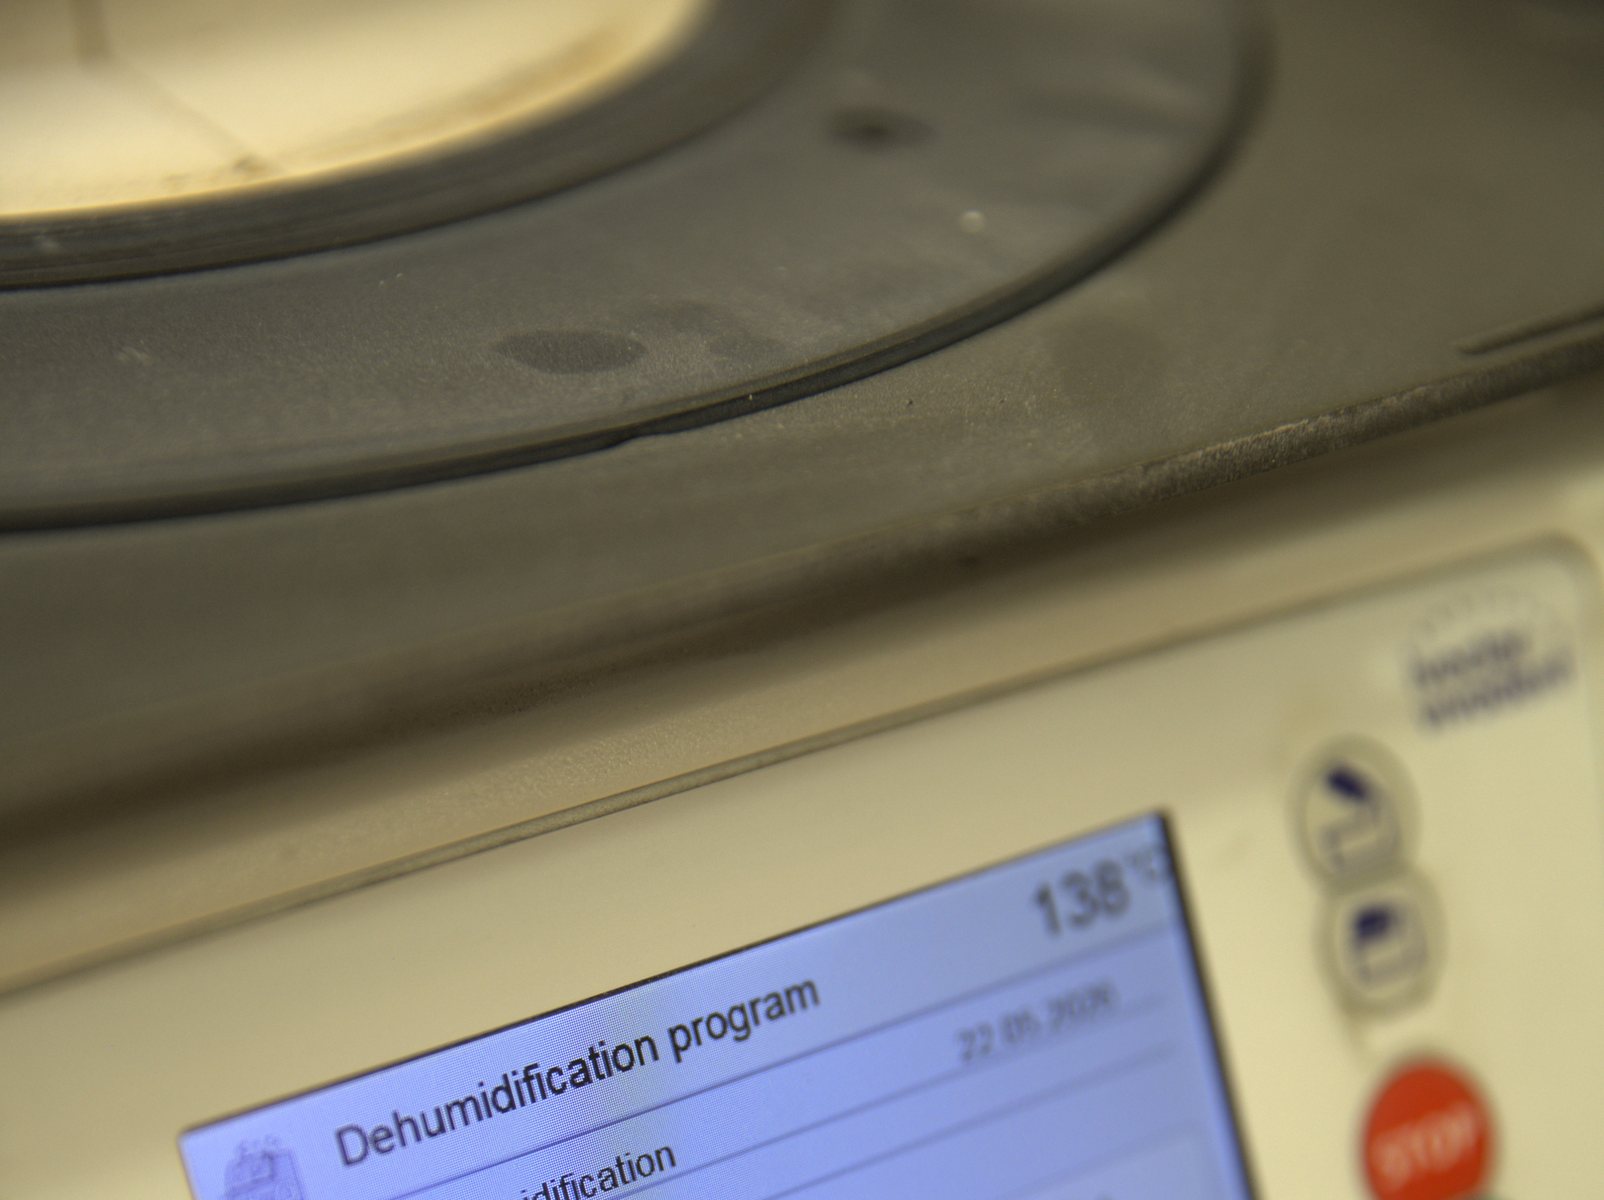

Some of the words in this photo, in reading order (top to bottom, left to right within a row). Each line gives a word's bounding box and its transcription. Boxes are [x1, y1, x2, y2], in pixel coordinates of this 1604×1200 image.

[335, 1034, 660, 1168] Dehumidification
[668, 978, 822, 1064] program
[1372, 1102, 1479, 1186] STOP
